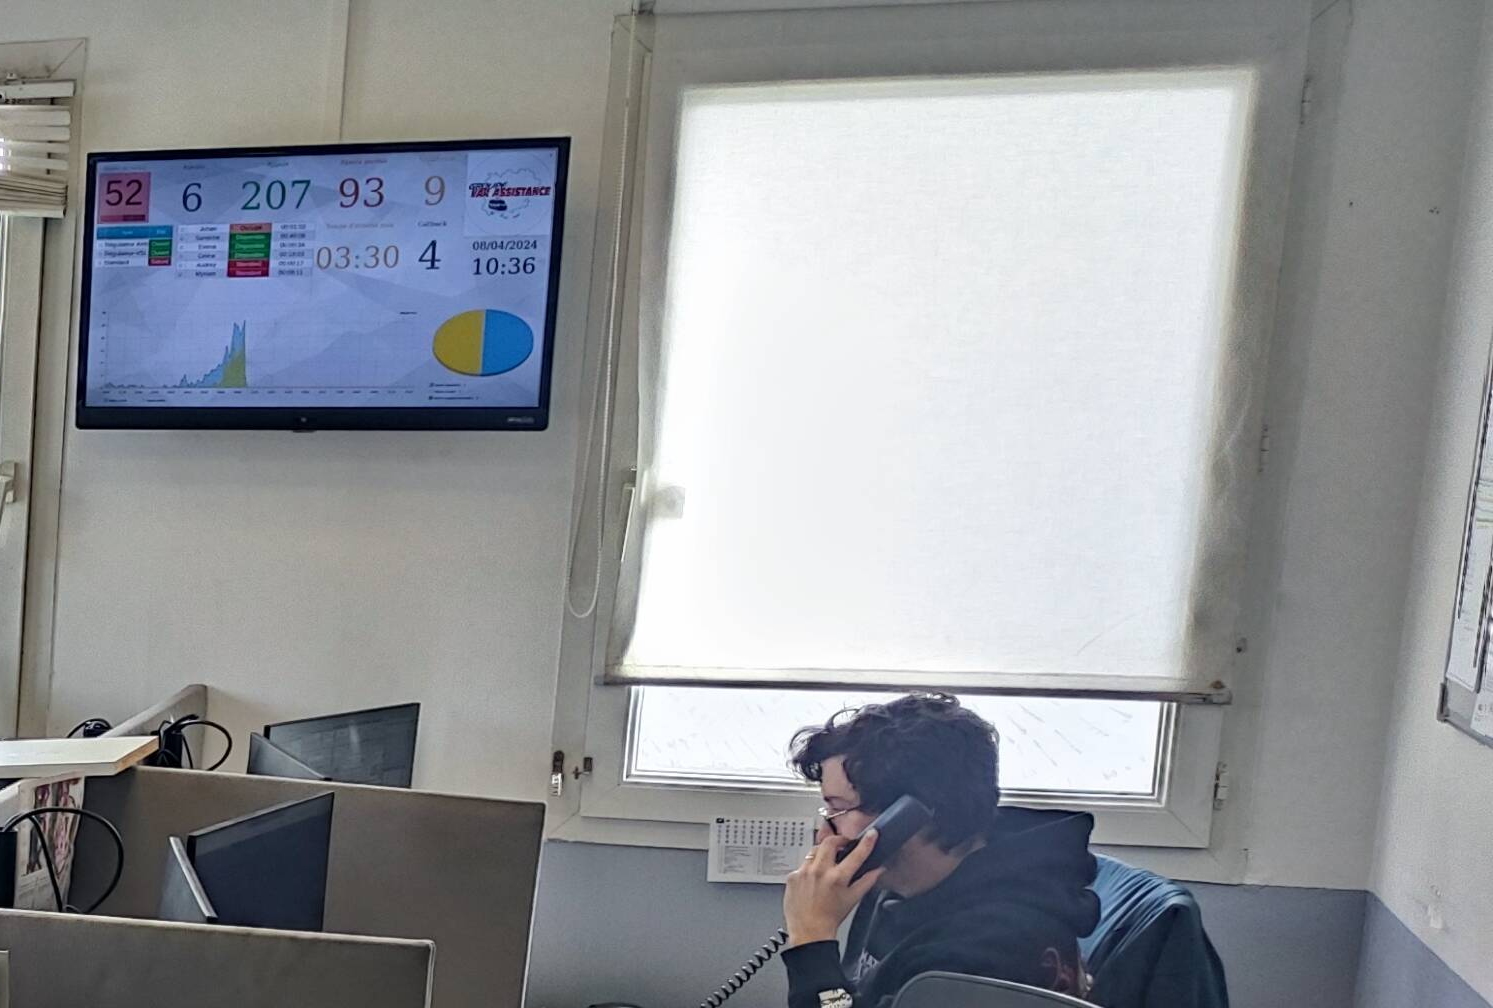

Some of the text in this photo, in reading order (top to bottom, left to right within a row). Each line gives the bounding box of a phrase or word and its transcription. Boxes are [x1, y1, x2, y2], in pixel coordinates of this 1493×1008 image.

[105, 175, 446, 212] 52 6 207 93 9
[492, 185, 551, 198] ASSISTANCE
[316, 239, 441, 270] 03:30 4
[472, 240, 538, 251] 08/04/2024
[472, 257, 536, 275] 10:36
